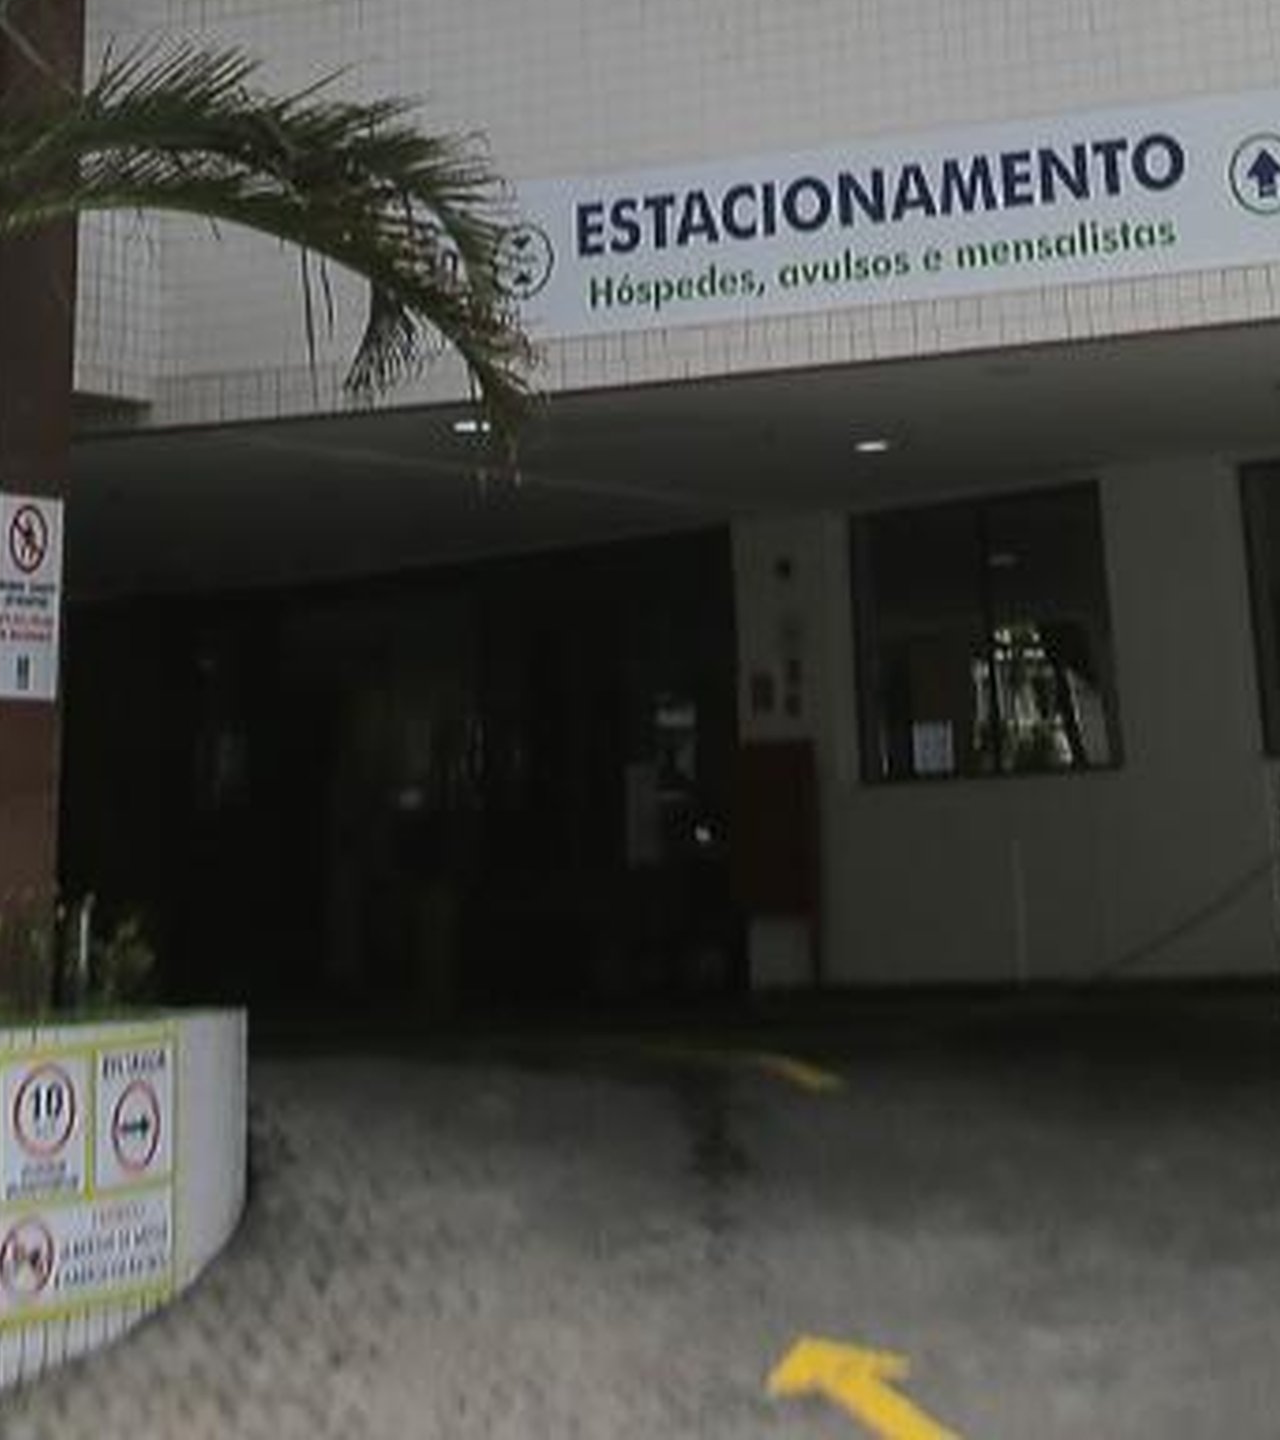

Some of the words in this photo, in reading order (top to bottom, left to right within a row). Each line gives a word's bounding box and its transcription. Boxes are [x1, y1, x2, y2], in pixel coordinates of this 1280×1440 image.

[575, 132, 1186, 258] ESTACIONAMENTO
[587, 262, 767, 313] Hóspedes,
[777, 247, 912, 288] avulsos
[922, 246, 942, 272] e
[956, 217, 1177, 269] mensalistas
[32, 1081, 63, 1120] 10
